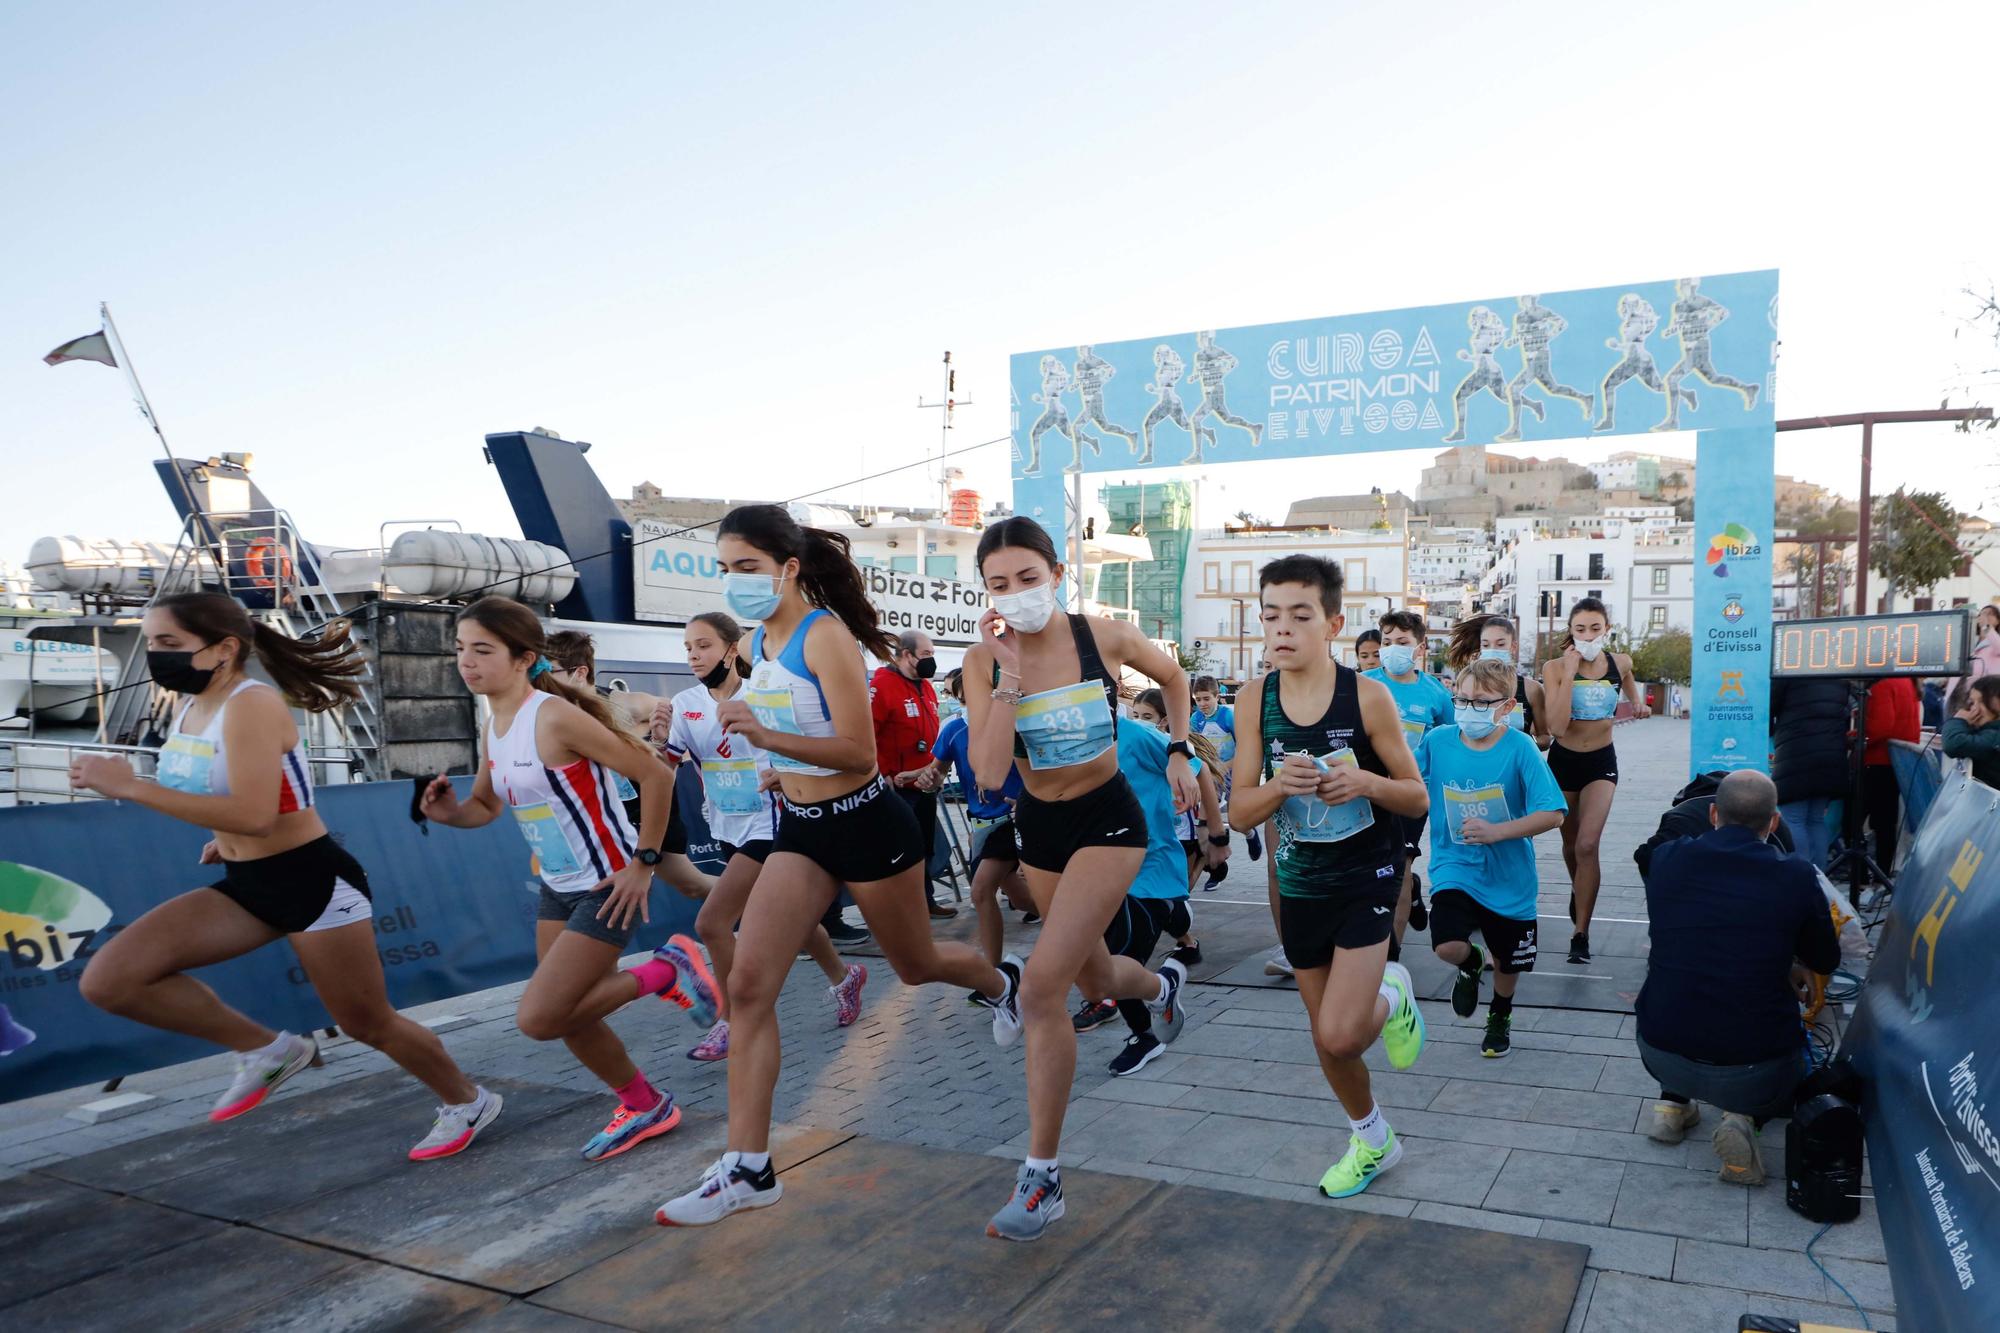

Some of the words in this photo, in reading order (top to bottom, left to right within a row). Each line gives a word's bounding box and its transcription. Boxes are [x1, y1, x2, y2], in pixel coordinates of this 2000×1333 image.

[1266, 325, 1441, 380] CURSA
[1270, 370, 1440, 416] PATRIMONI
[1267, 398, 1444, 440] EIVISSA
[642, 523, 697, 539] NAVIERA
[1726, 543, 1761, 556] Ibiza
[650, 548, 724, 580] AQU
[863, 566, 925, 599] Ibiza
[878, 608, 912, 628] nea
[918, 613, 977, 636] regular
[1708, 627, 1757, 639] Consell
[1703, 641, 1762, 652] d'Eivissa
[1584, 686, 1606, 700] 328
[1042, 706, 1085, 733] 333
[716, 771, 742, 787] 380
[832, 782, 880, 815] NIKE
[1458, 802, 1488, 818] 386
[690, 842, 712, 854] Port
[1914, 1147, 1939, 1189] Autoritat
[1929, 1180, 1957, 1235] Portuària
[1944, 1227, 1963, 1248] de
[1949, 1240, 1975, 1291] Balears
